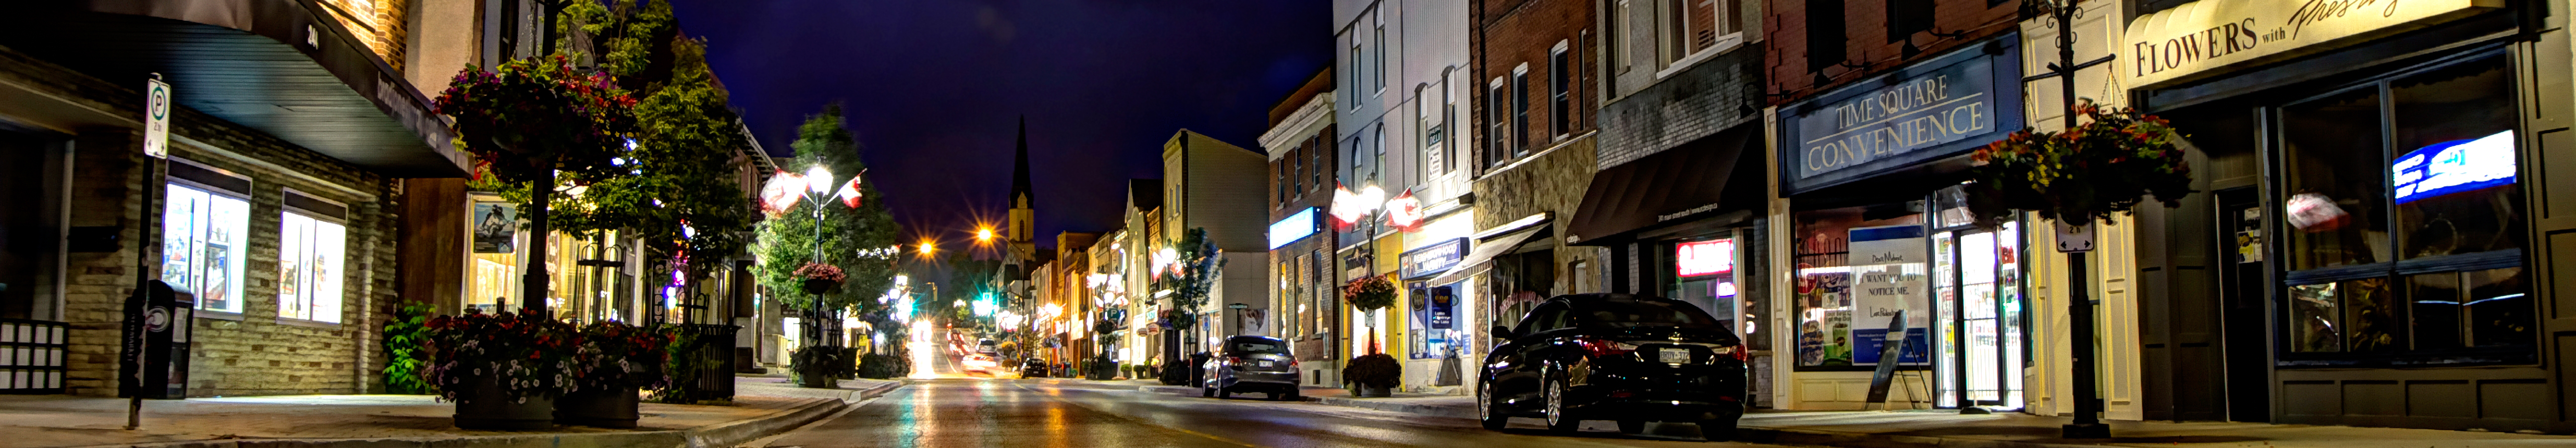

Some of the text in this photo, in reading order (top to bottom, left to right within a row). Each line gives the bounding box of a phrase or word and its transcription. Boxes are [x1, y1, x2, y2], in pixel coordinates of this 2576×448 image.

[308, 24, 318, 50] 244
[2134, 17, 2257, 78] FLOWERS
[2262, 27, 2285, 44] with
[155, 95, 162, 111] P
[1836, 74, 1948, 129] TIME SQUARE
[1430, 132, 1440, 145] DELI
[1807, 101, 1983, 172] CONVENIENCE
[1866, 274, 1887, 283] WANT
[1889, 273, 1904, 282] YOU
[1907, 273, 1916, 281] TO
[1868, 287, 1909, 296] NOTICE ME.
[1110, 309, 1117, 317] P
